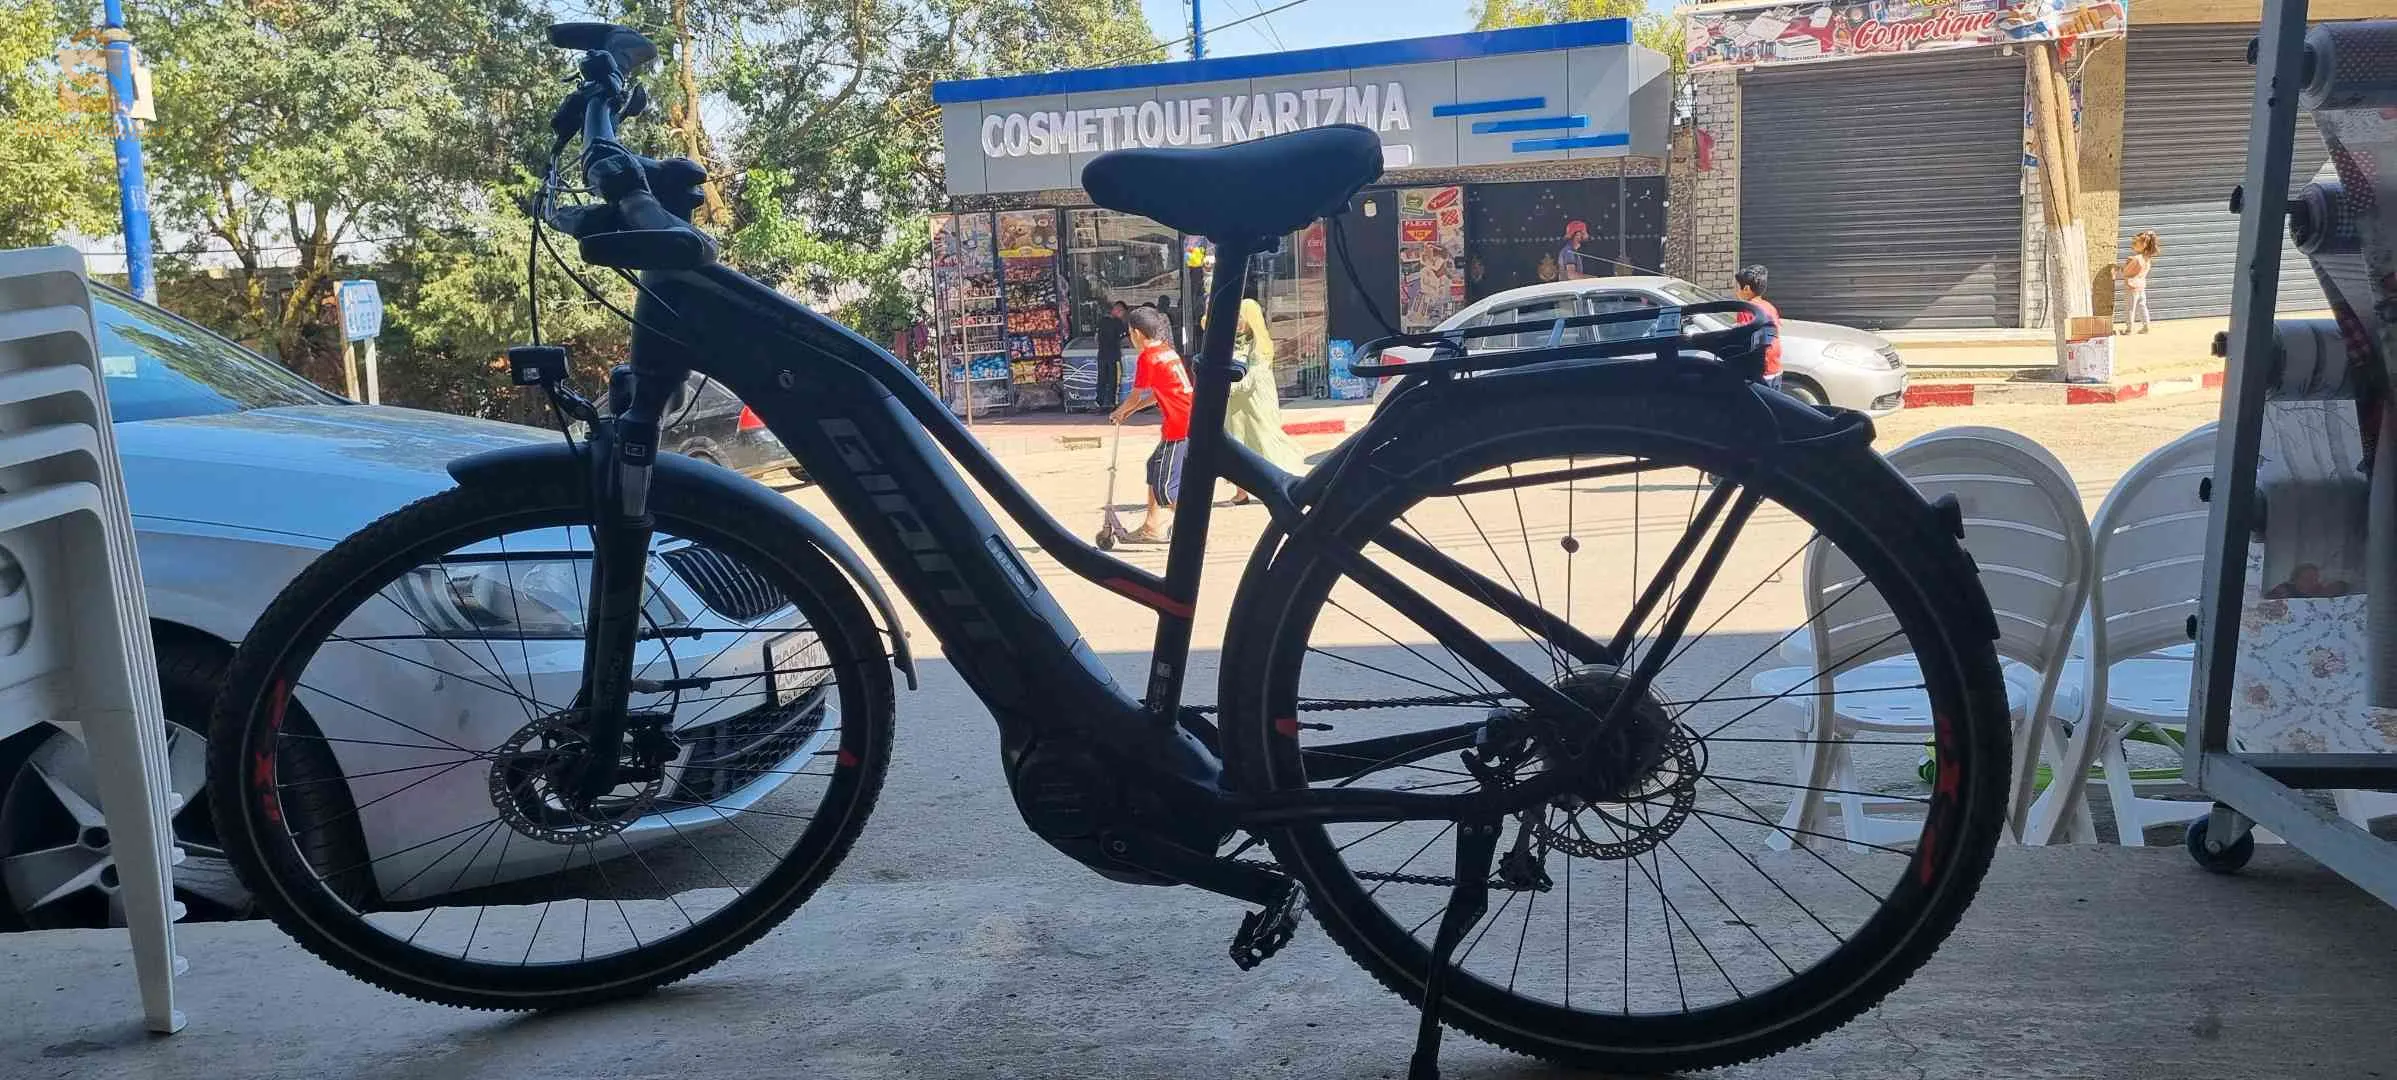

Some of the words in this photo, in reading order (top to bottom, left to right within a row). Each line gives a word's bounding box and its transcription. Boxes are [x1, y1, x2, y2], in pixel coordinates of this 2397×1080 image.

[1854, 7, 1997, 48] Cosmetique
[981, 97, 1212, 157] COSMETIQUE
[1221, 82, 1412, 144] KARIZMA
